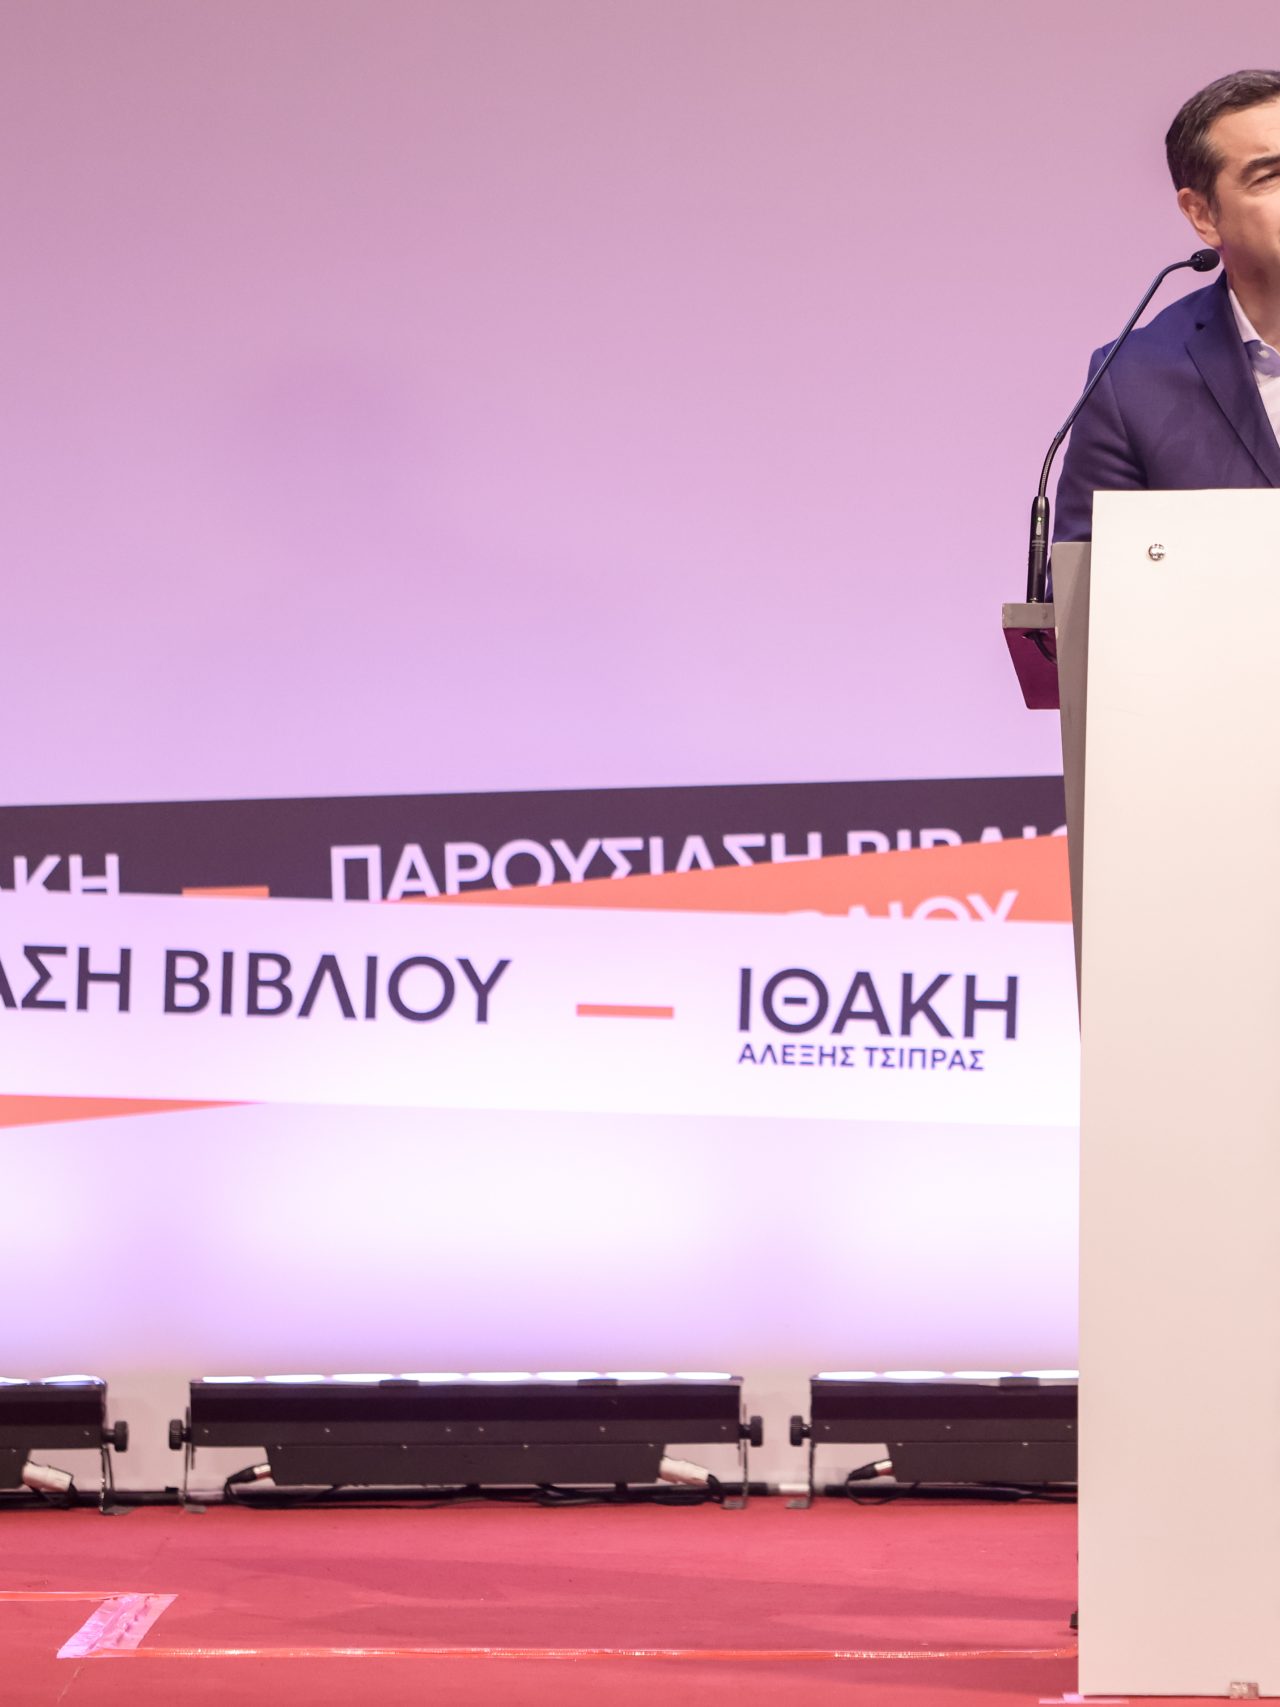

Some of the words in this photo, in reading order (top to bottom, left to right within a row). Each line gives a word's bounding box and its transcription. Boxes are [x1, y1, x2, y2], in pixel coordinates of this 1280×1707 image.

[163, 949, 512, 1023] ΒΙΒΛΙΟΥ
[738, 967, 1018, 1040] ΙΘΑΚΗ
[738, 1043, 855, 1068] ΑΛΕΞΗΣ
[864, 1046, 984, 1072] ΤΣΙΠΡΑΣ
